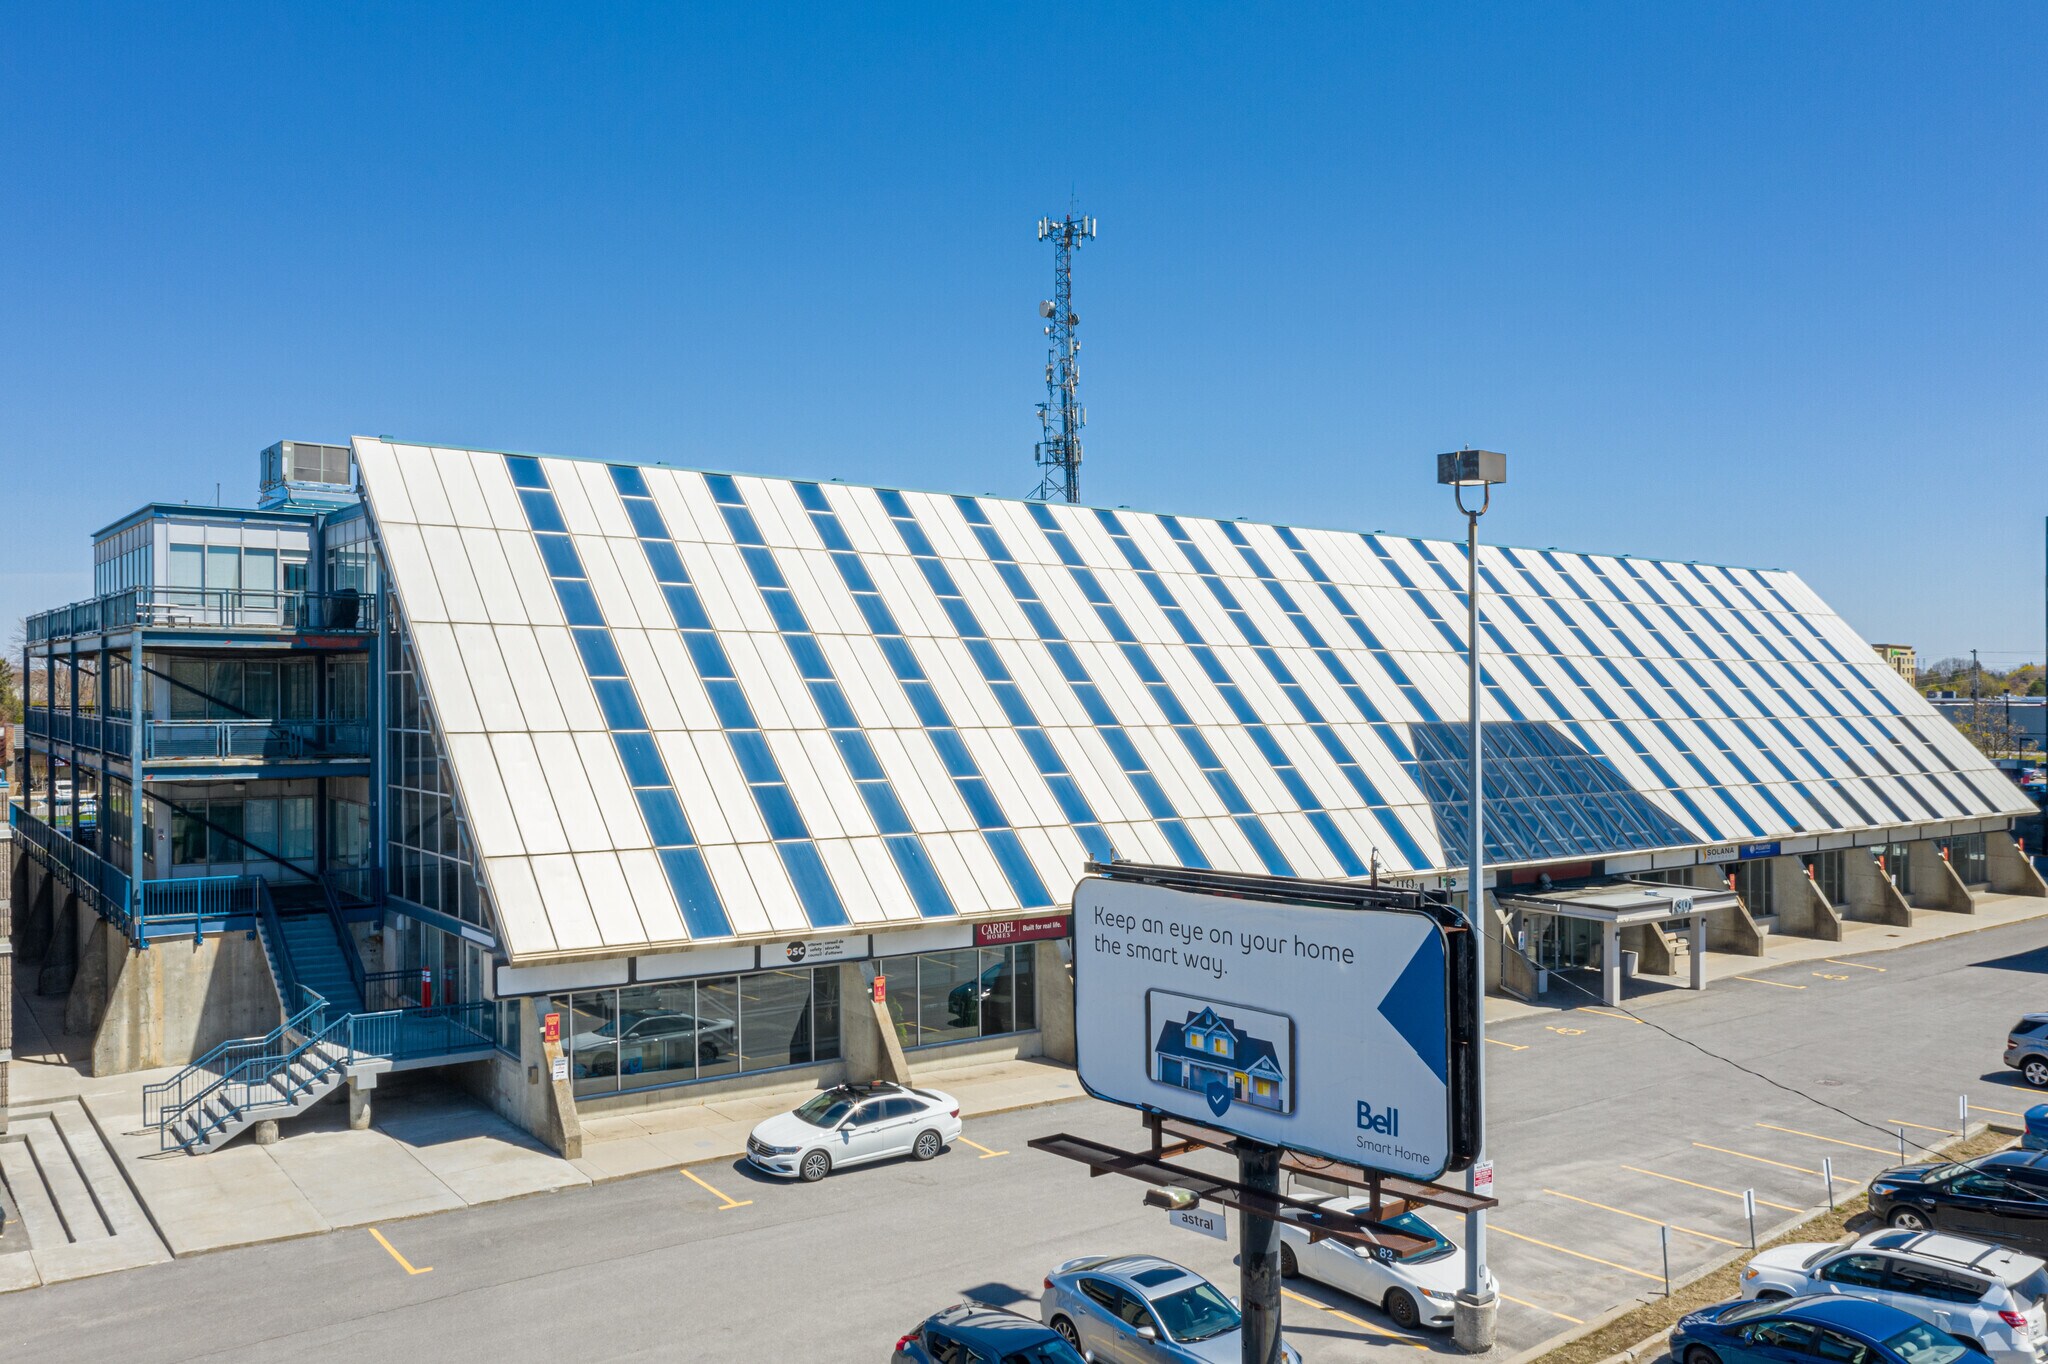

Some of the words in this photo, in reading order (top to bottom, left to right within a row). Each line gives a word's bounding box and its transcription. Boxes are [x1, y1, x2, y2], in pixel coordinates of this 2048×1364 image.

[1707, 847, 1734, 856] SOLANA
[981, 922, 1016, 936] CARDEL
[986, 932, 1011, 940] HOMES
[1022, 924, 1035, 932] Built
[1094, 905, 1136, 934] Keep
[1142, 918, 1163, 935] an
[1169, 922, 1203, 945] eye
[1209, 928, 1233, 945] on
[1240, 932, 1288, 955] your
[1294, 934, 1355, 964] home
[1094, 933, 1121, 955] the
[1126, 943, 1178, 965] smart
[1183, 952, 1228, 979] way.
[1357, 1099, 1399, 1137] Bell
[1356, 1135, 1392, 1155] Smart
[1394, 1144, 1430, 1165] Home
[1181, 1213, 1214, 1231] astral
[1379, 1247, 1394, 1261] 82
